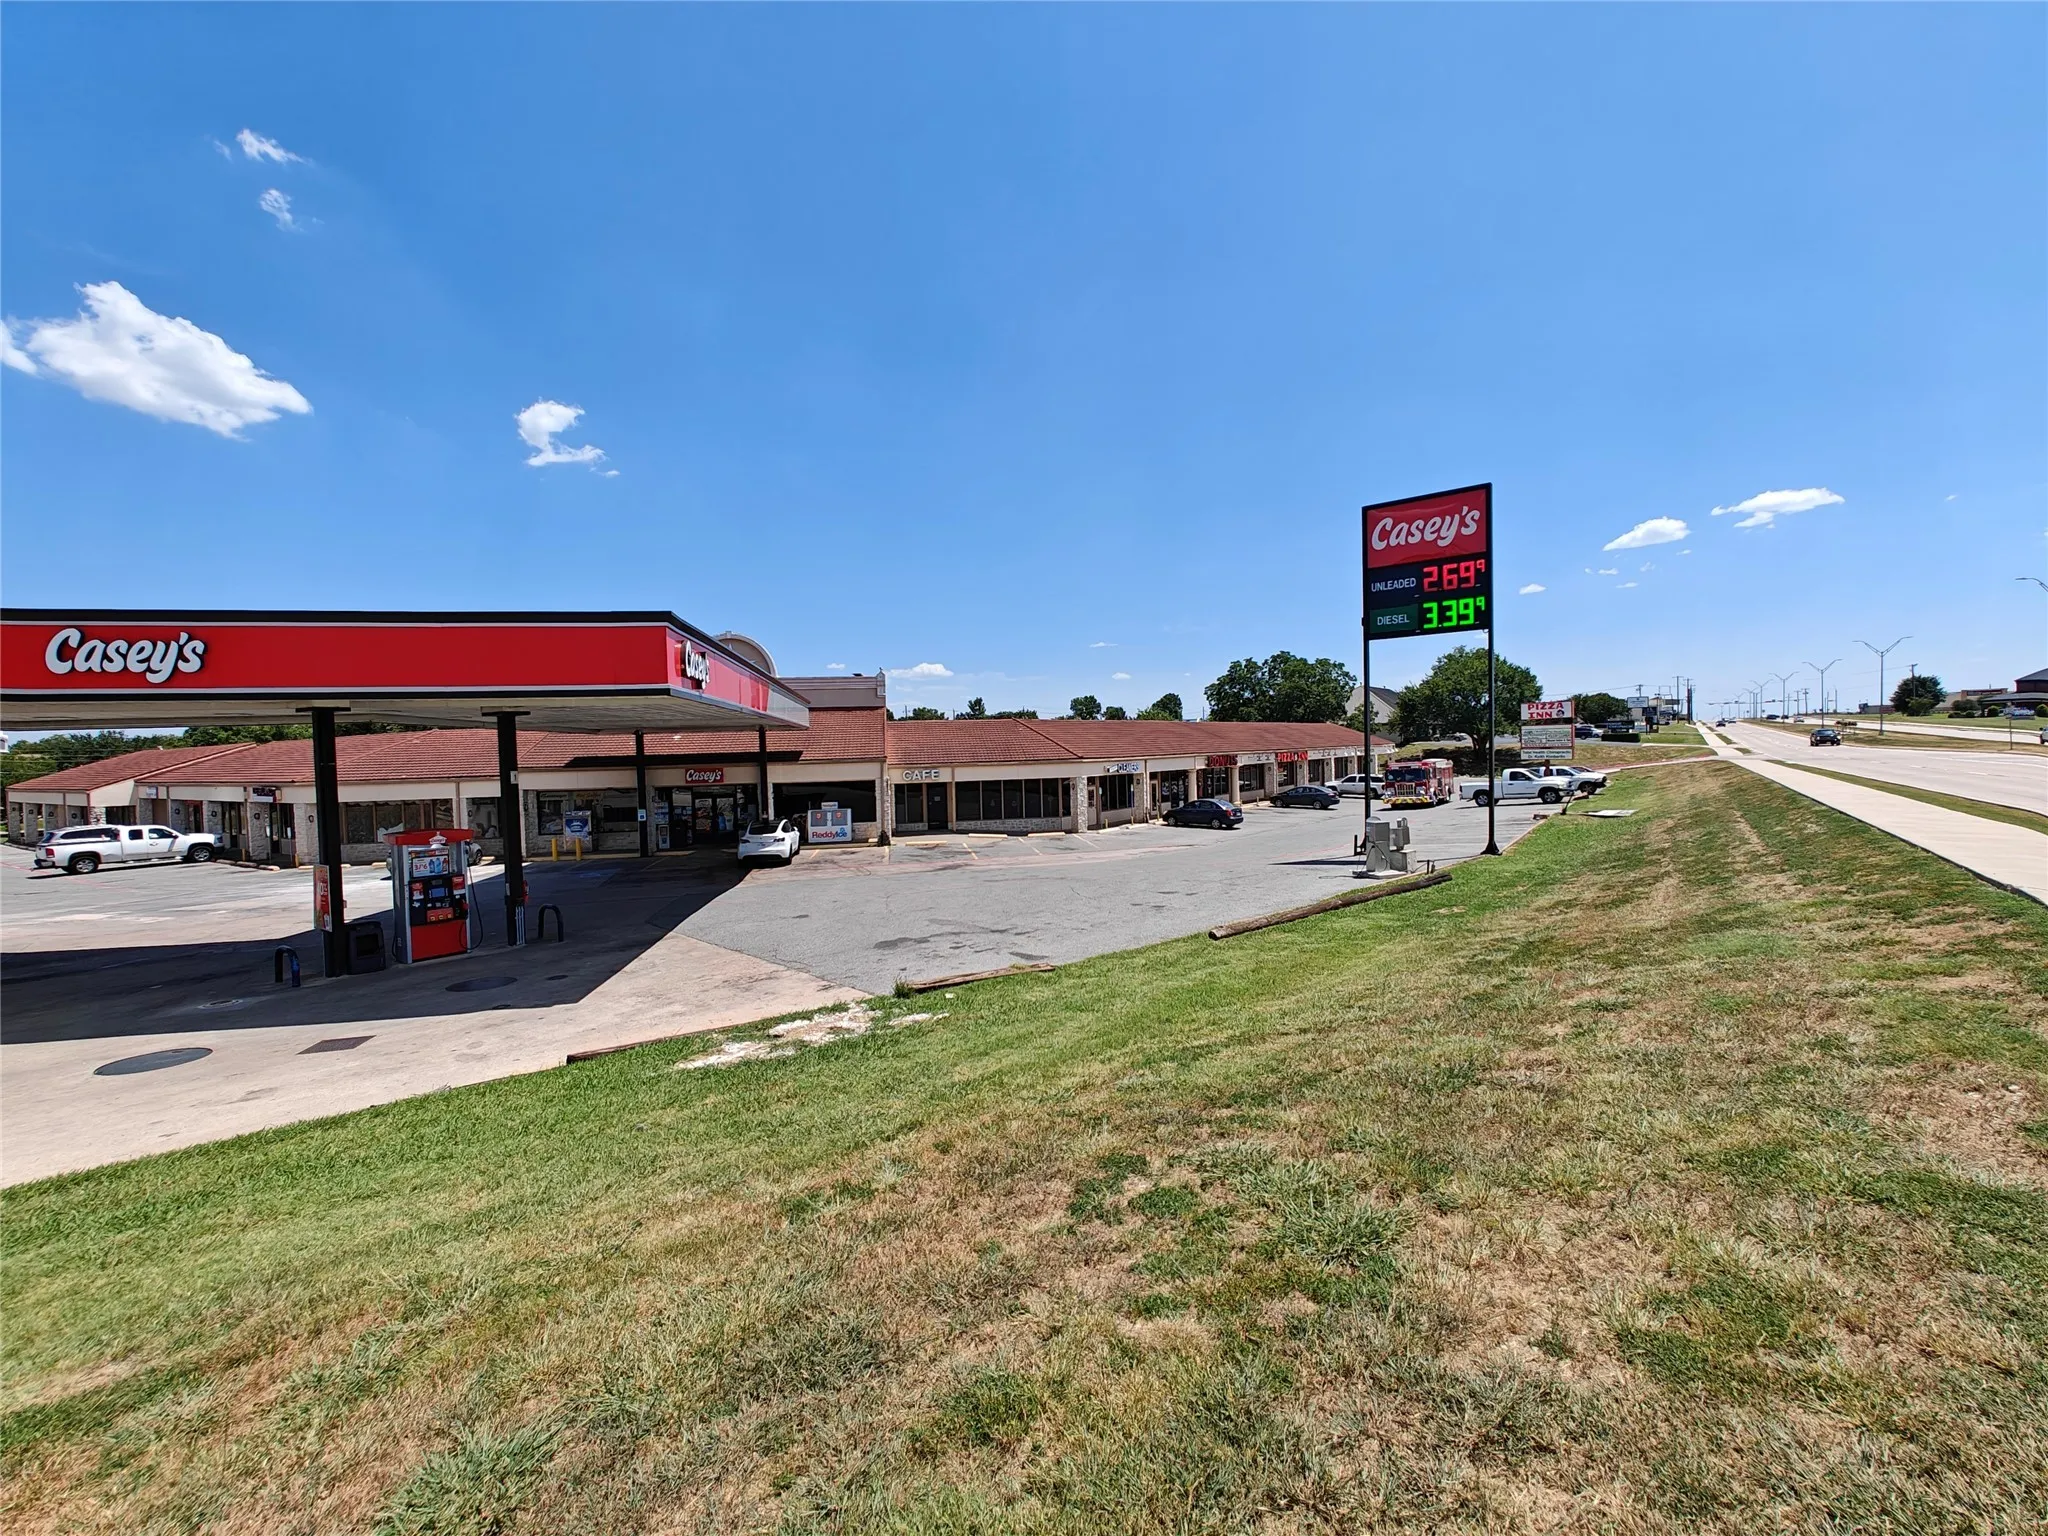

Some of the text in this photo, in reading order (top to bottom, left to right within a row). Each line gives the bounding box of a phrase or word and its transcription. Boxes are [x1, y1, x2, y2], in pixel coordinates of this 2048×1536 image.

[1371, 505, 1481, 551] Casey's
[1371, 577, 1417, 592] UNLEADED
[1377, 614, 1411, 626] DIESEL
[45, 627, 206, 684] Casey's
[685, 639, 711, 690] Casey's
[1527, 702, 1564, 711] PIZZA
[1528, 711, 1553, 719] INN
[686, 769, 722, 783] Casey's
[902, 769, 940, 781] CAFE
